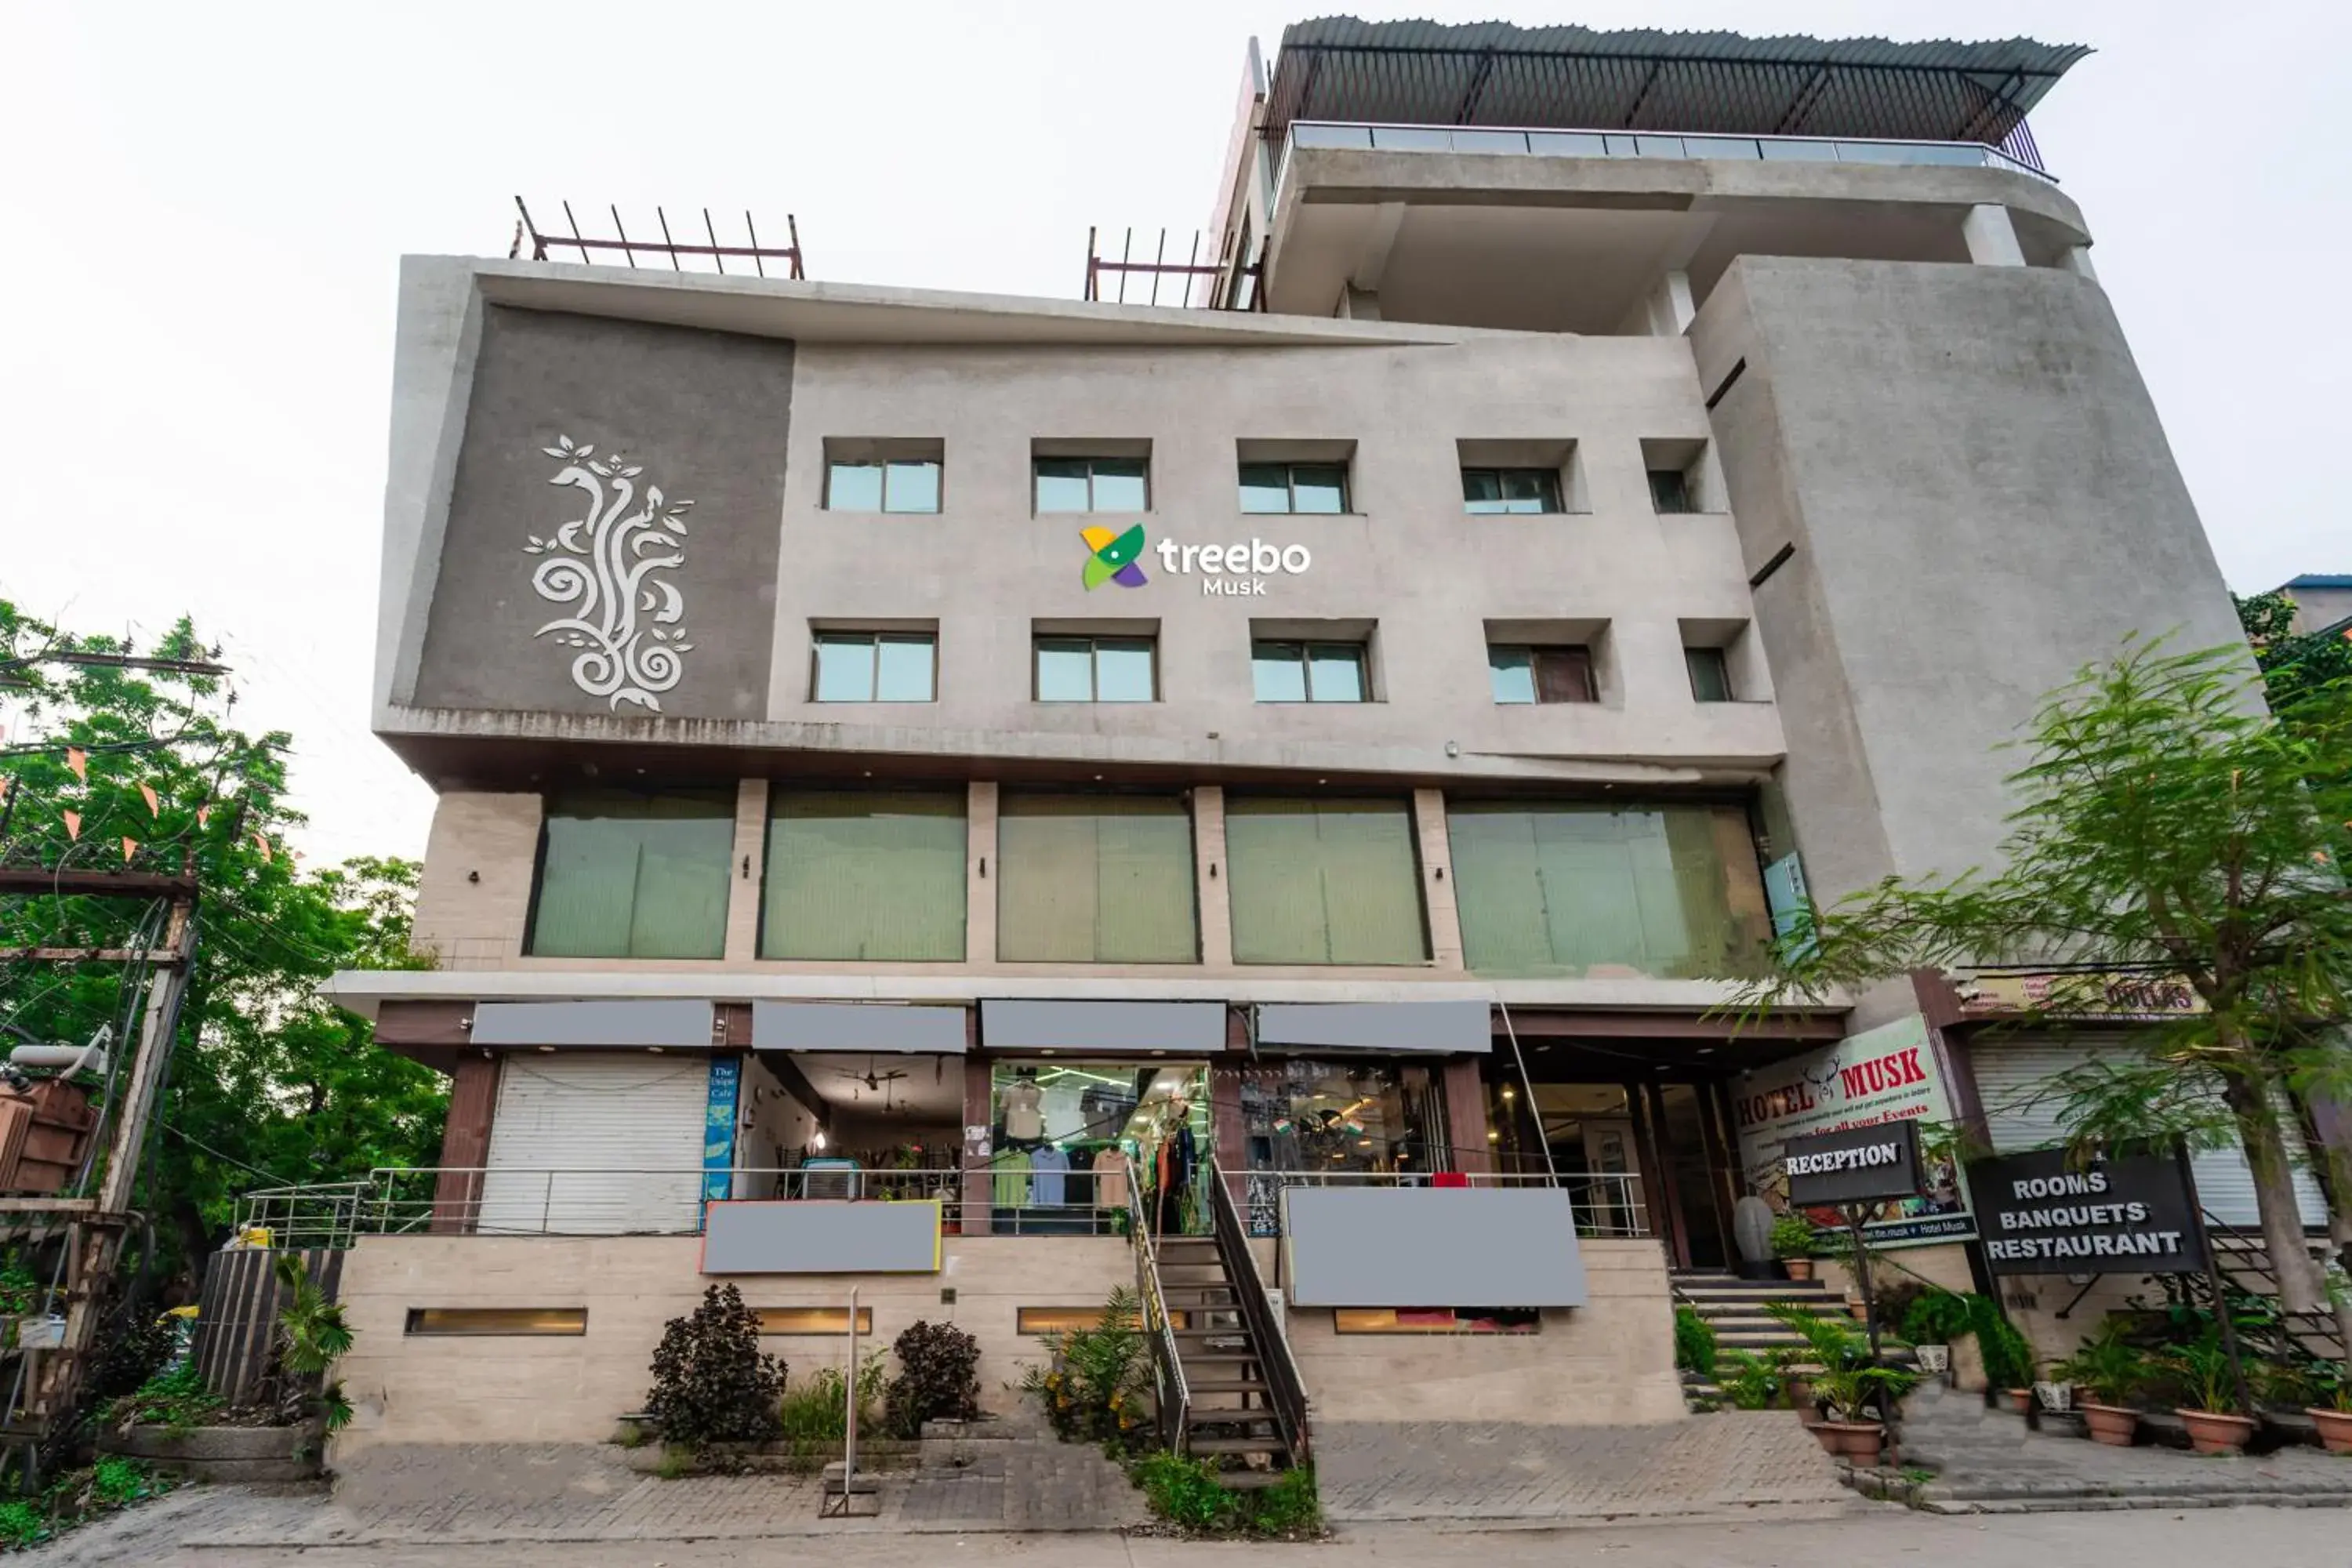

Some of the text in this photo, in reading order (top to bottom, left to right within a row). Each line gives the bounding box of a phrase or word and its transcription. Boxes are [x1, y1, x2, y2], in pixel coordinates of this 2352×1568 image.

[1156, 538, 1311, 574] treebo
[1202, 578, 1267, 596] Musk
[714, 1066, 734, 1076] The
[1737, 1047, 1927, 1127] HOTEL MUSK
[1881, 1103, 1929, 1123] Events
[1786, 1142, 1898, 1176] RECEPTION
[2013, 1173, 2107, 1200] ROOMS
[1920, 1223, 1941, 1235] Hotel
[1941, 1220, 1968, 1232] Musk
[2000, 1202, 2147, 1230] BANQUETS
[1987, 1232, 2182, 1260] RESTAURANT
